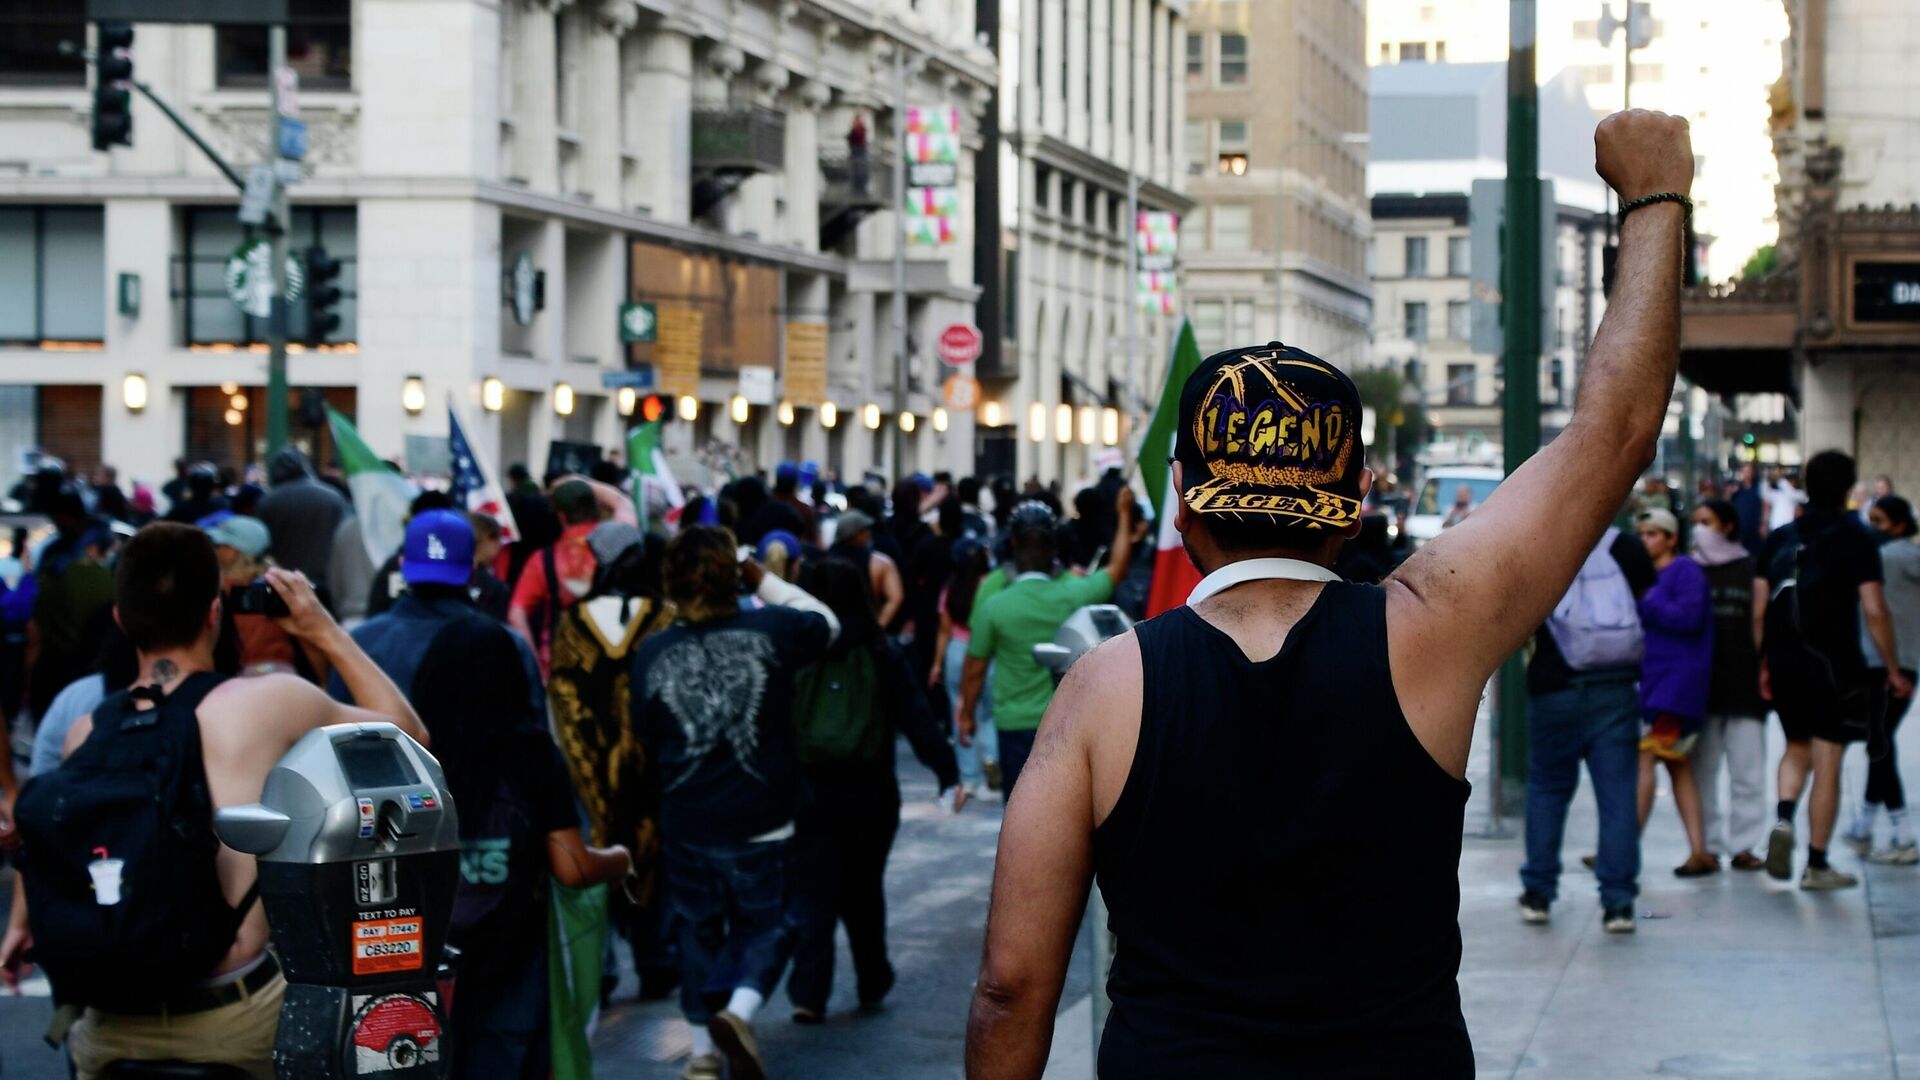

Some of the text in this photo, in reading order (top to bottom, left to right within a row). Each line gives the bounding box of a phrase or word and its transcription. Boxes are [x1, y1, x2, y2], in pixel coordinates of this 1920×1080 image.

[1205, 402, 1343, 461] LEGEND
[360, 865, 370, 902] COINS
[359, 907, 416, 921] TEXT TO PAY
[363, 924, 418, 936] PAY 77447
[365, 941, 411, 957] CB3220
